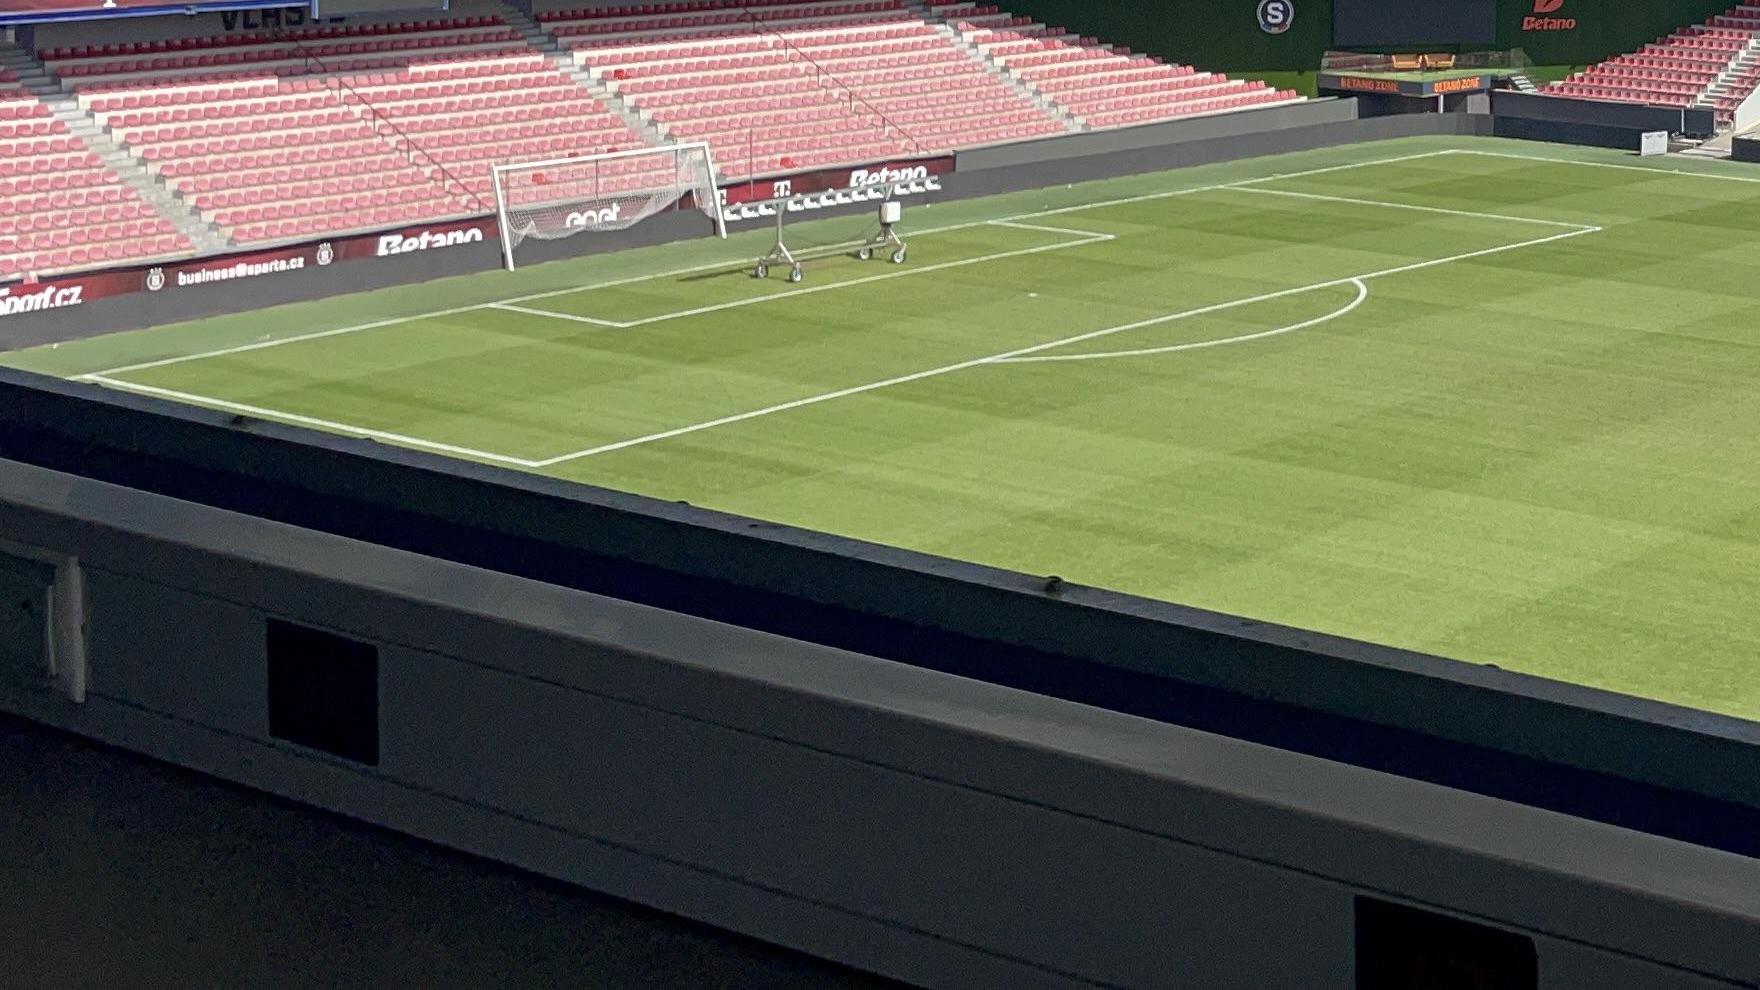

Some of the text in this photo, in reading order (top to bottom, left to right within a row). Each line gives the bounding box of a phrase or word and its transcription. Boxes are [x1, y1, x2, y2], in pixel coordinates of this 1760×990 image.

[1521, 16, 1577, 31] Betano
[774, 180, 791, 197] T
[178, 256, 304, 286] business@sparta.cz
